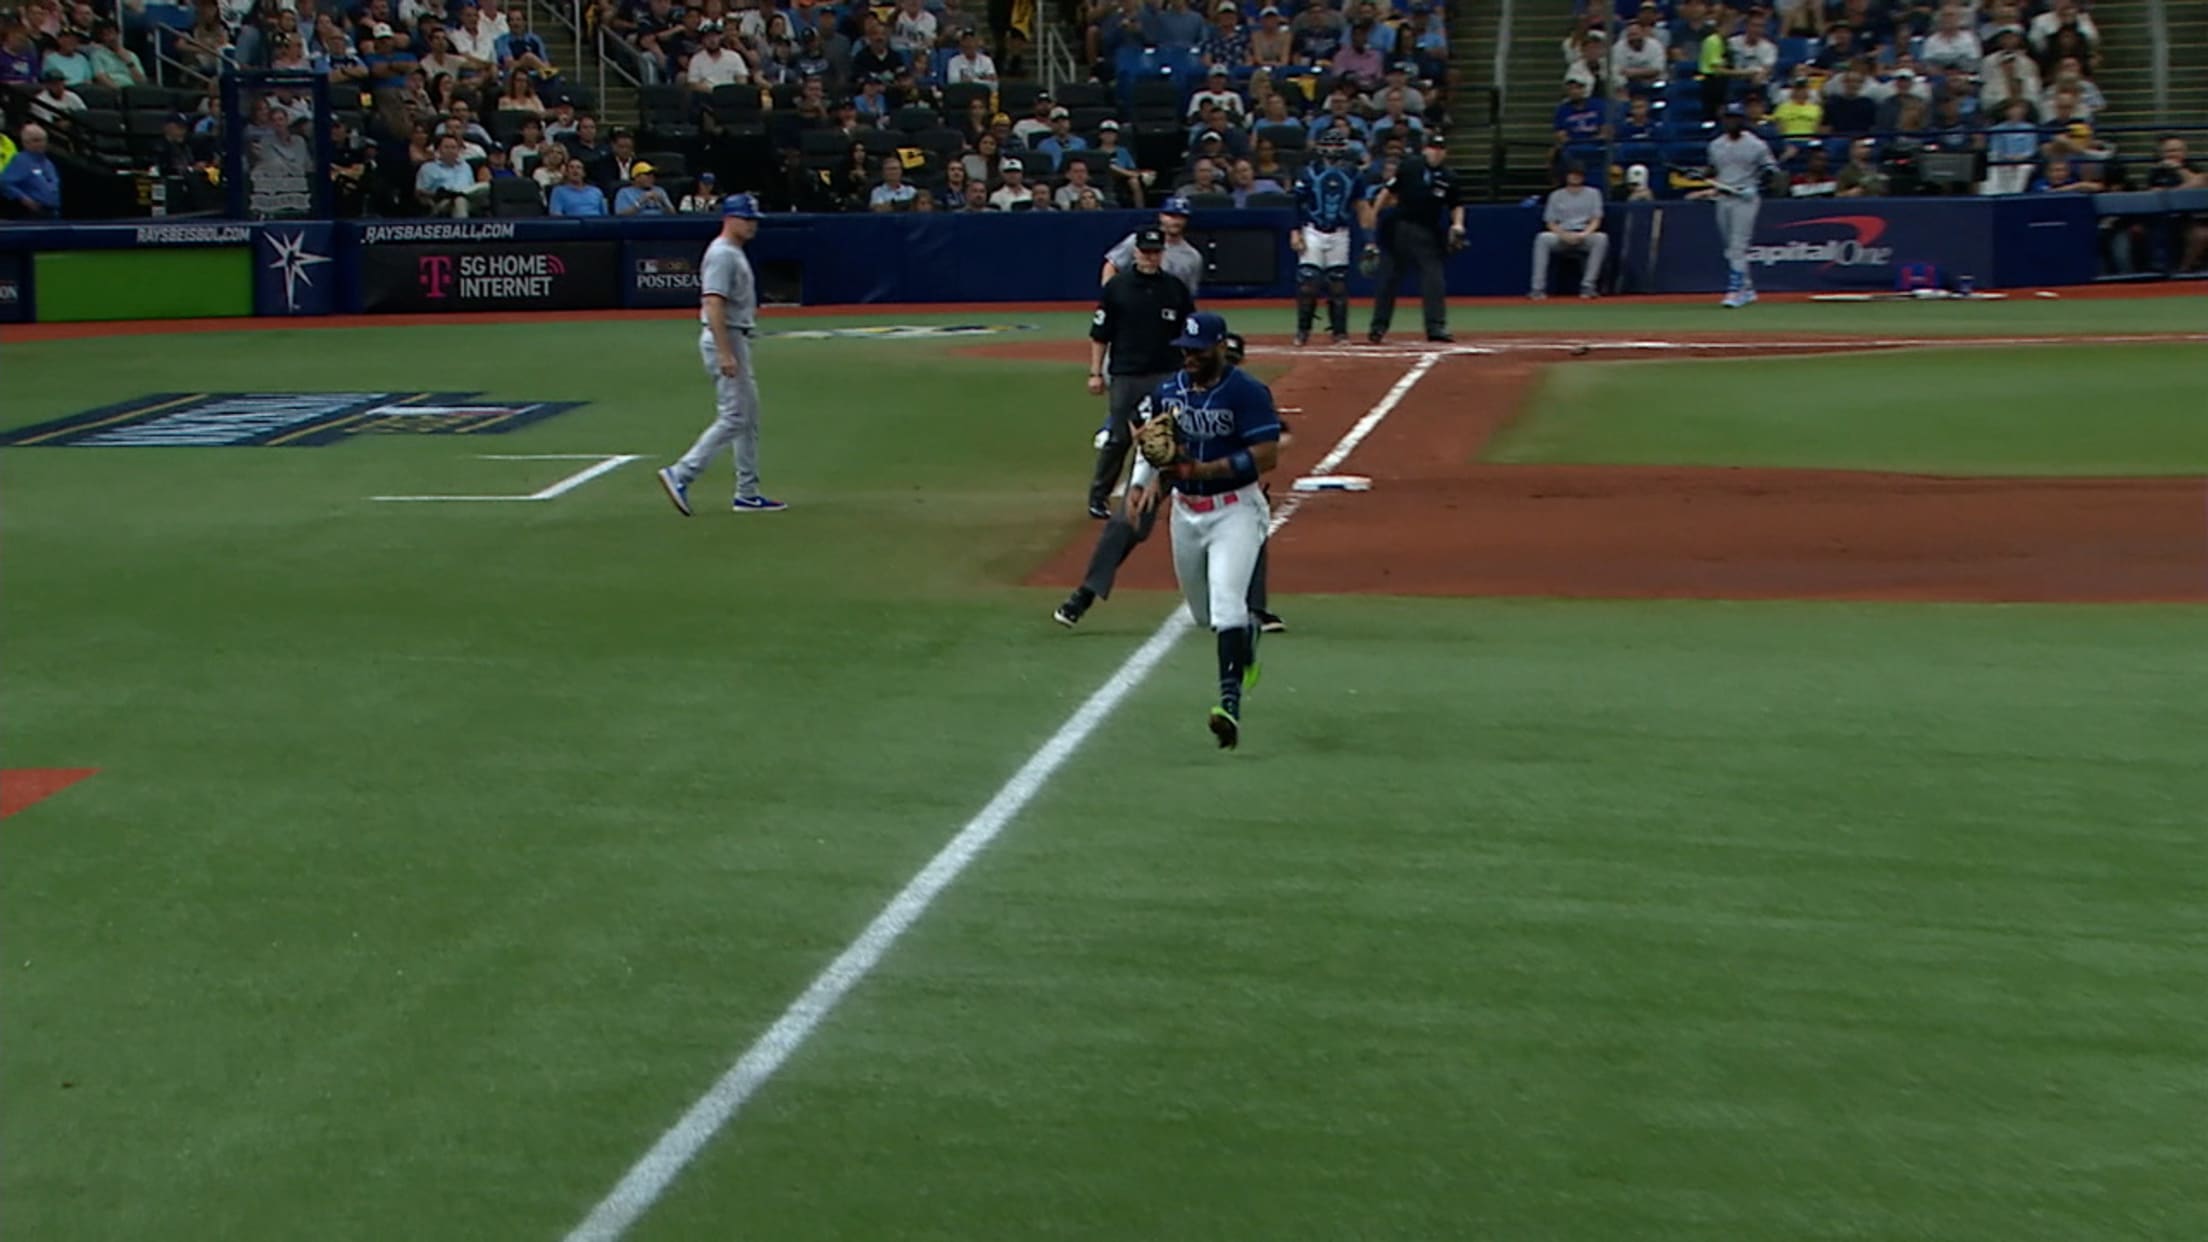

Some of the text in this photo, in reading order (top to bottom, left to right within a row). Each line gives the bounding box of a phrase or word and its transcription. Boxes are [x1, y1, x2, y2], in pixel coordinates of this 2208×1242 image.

[365, 224, 515, 240] RAYSBASEBALL.COM
[460, 255, 547, 276] 5G HOME
[460, 277, 552, 297] INTERNET
[636, 273, 703, 289] POSTSEA
